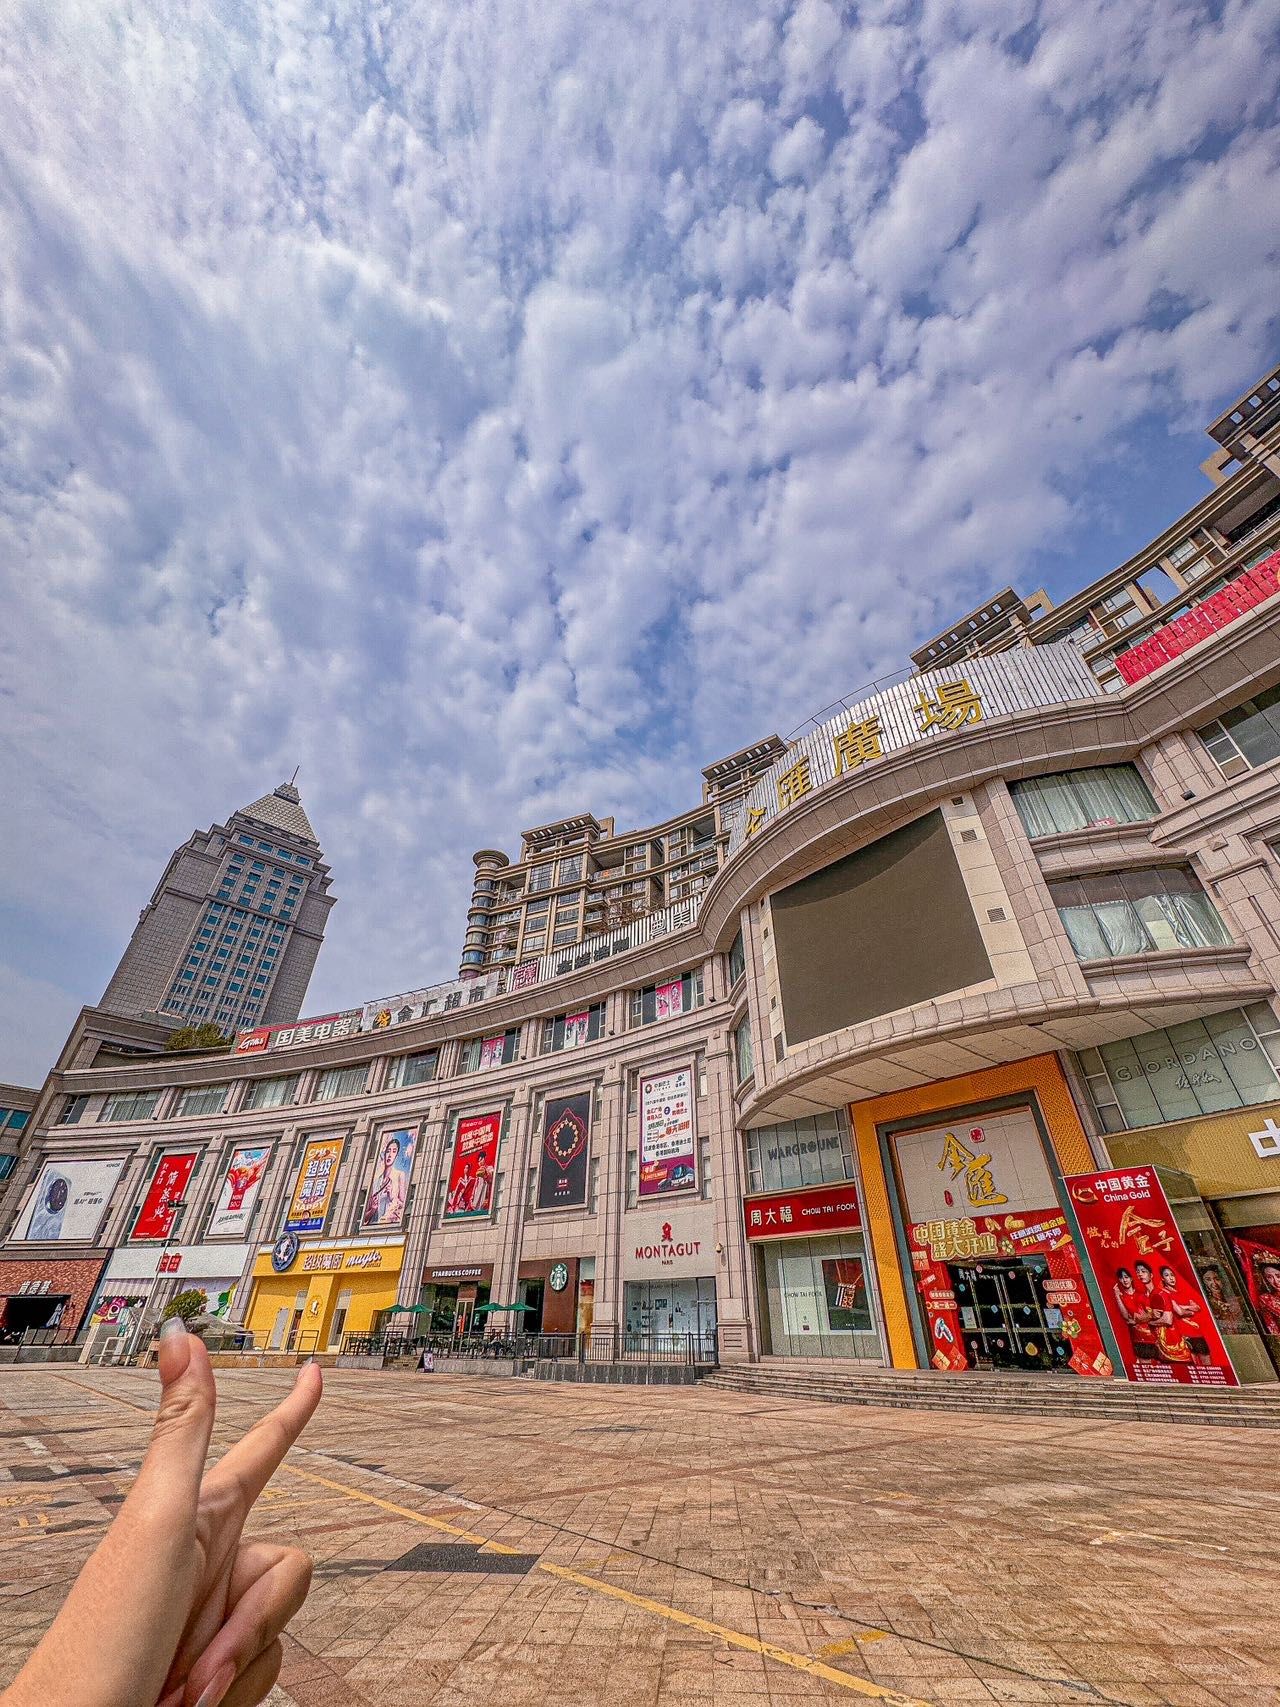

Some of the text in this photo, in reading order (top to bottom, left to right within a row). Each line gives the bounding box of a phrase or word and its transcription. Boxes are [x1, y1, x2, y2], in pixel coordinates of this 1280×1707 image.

[275, 1018, 352, 1049] 国美电器
[1115, 1037, 1257, 1081] GIORDANO
[1094, 1174, 1150, 1193] 中国黄金
[294, 1201, 326, 1211] HAPPY
[1103, 1190, 1151, 1203] China Gold
[750, 1206, 793, 1227] 周大福
[801, 1203, 856, 1216] CHOW TAI FOOK
[914, 1219, 975, 1245] 中国黄金
[635, 1241, 700, 1259] MONTAGUT
[933, 1233, 997, 1260] 盛大开业
[431, 1268, 482, 1278] STARBUCKS COFFEE
